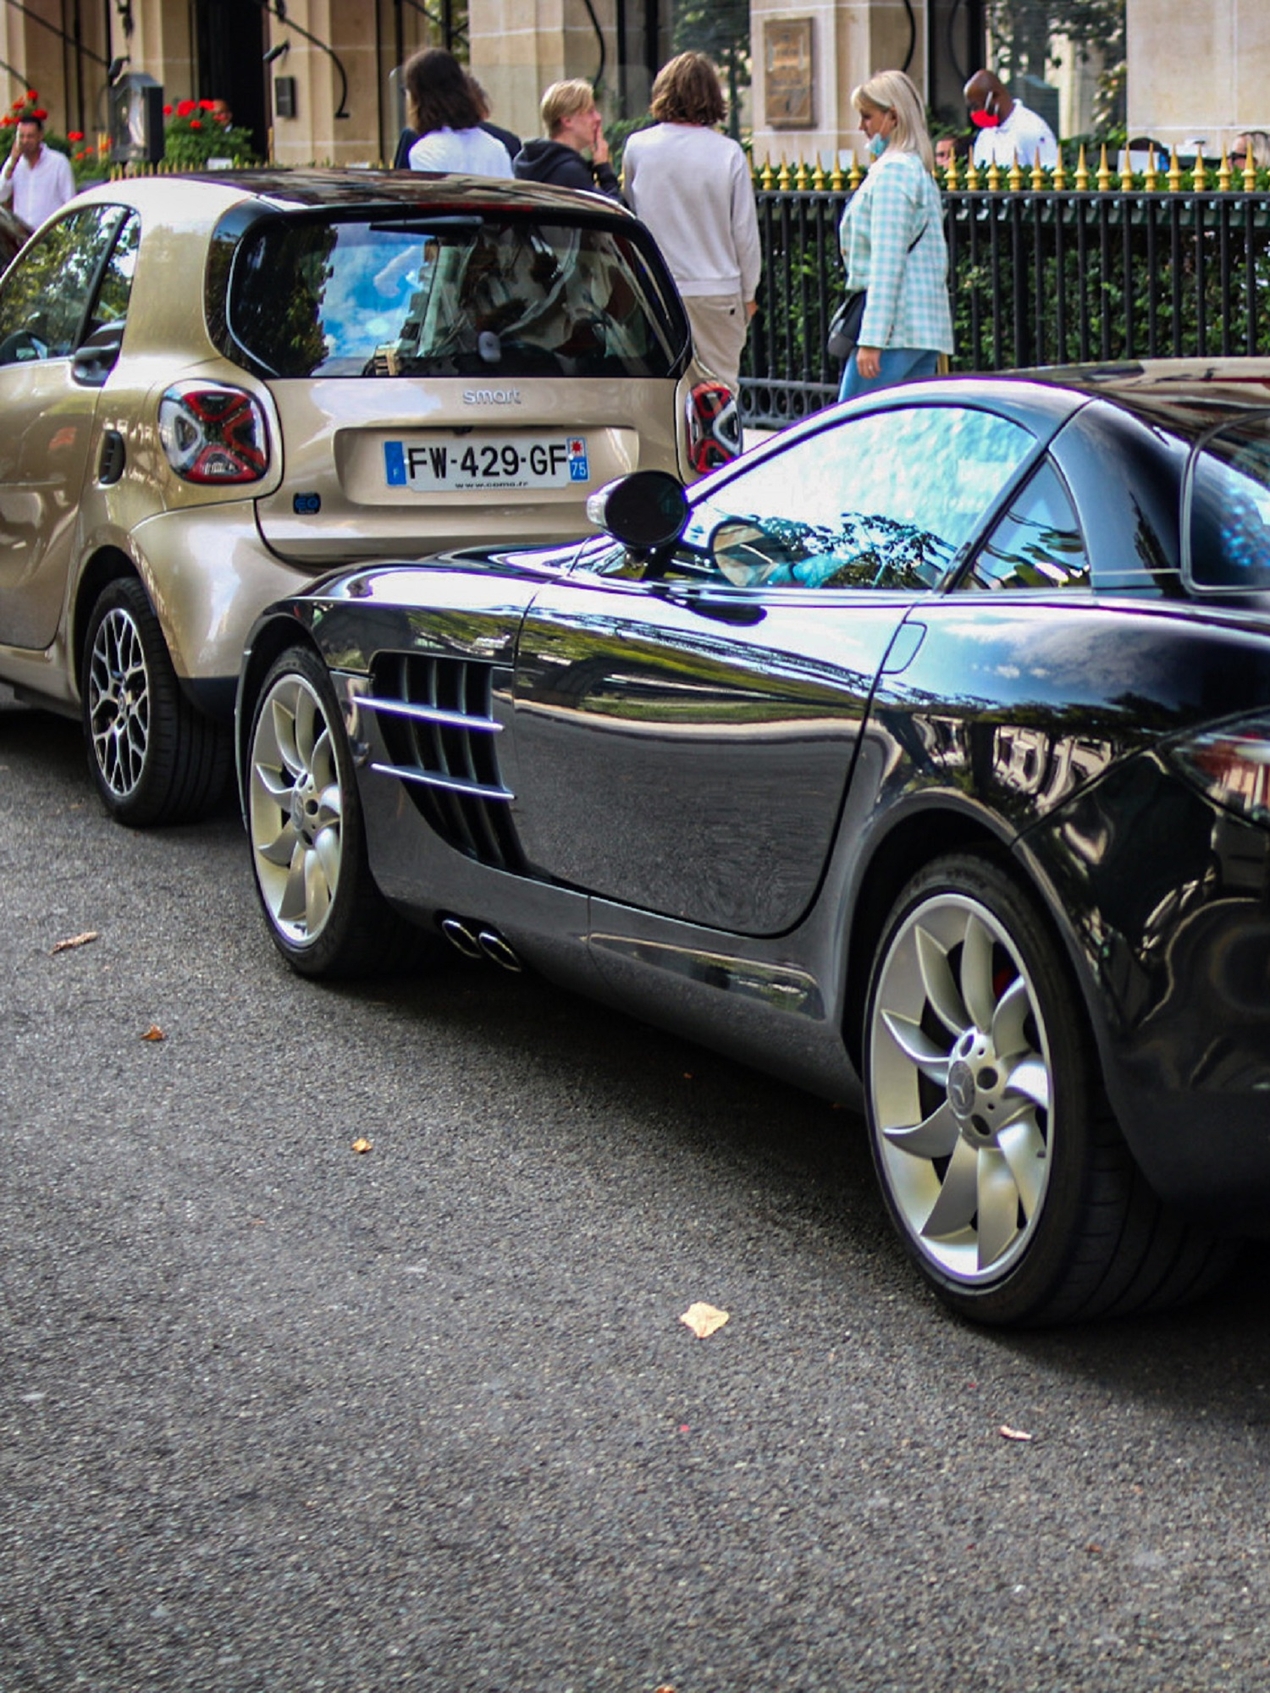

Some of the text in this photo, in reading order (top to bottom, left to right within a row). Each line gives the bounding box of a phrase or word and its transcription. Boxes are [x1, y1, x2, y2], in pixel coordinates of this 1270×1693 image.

[463, 388, 522, 405] smart
[407, 444, 568, 480] FW-429-GF
[572, 462, 587, 477] 75
